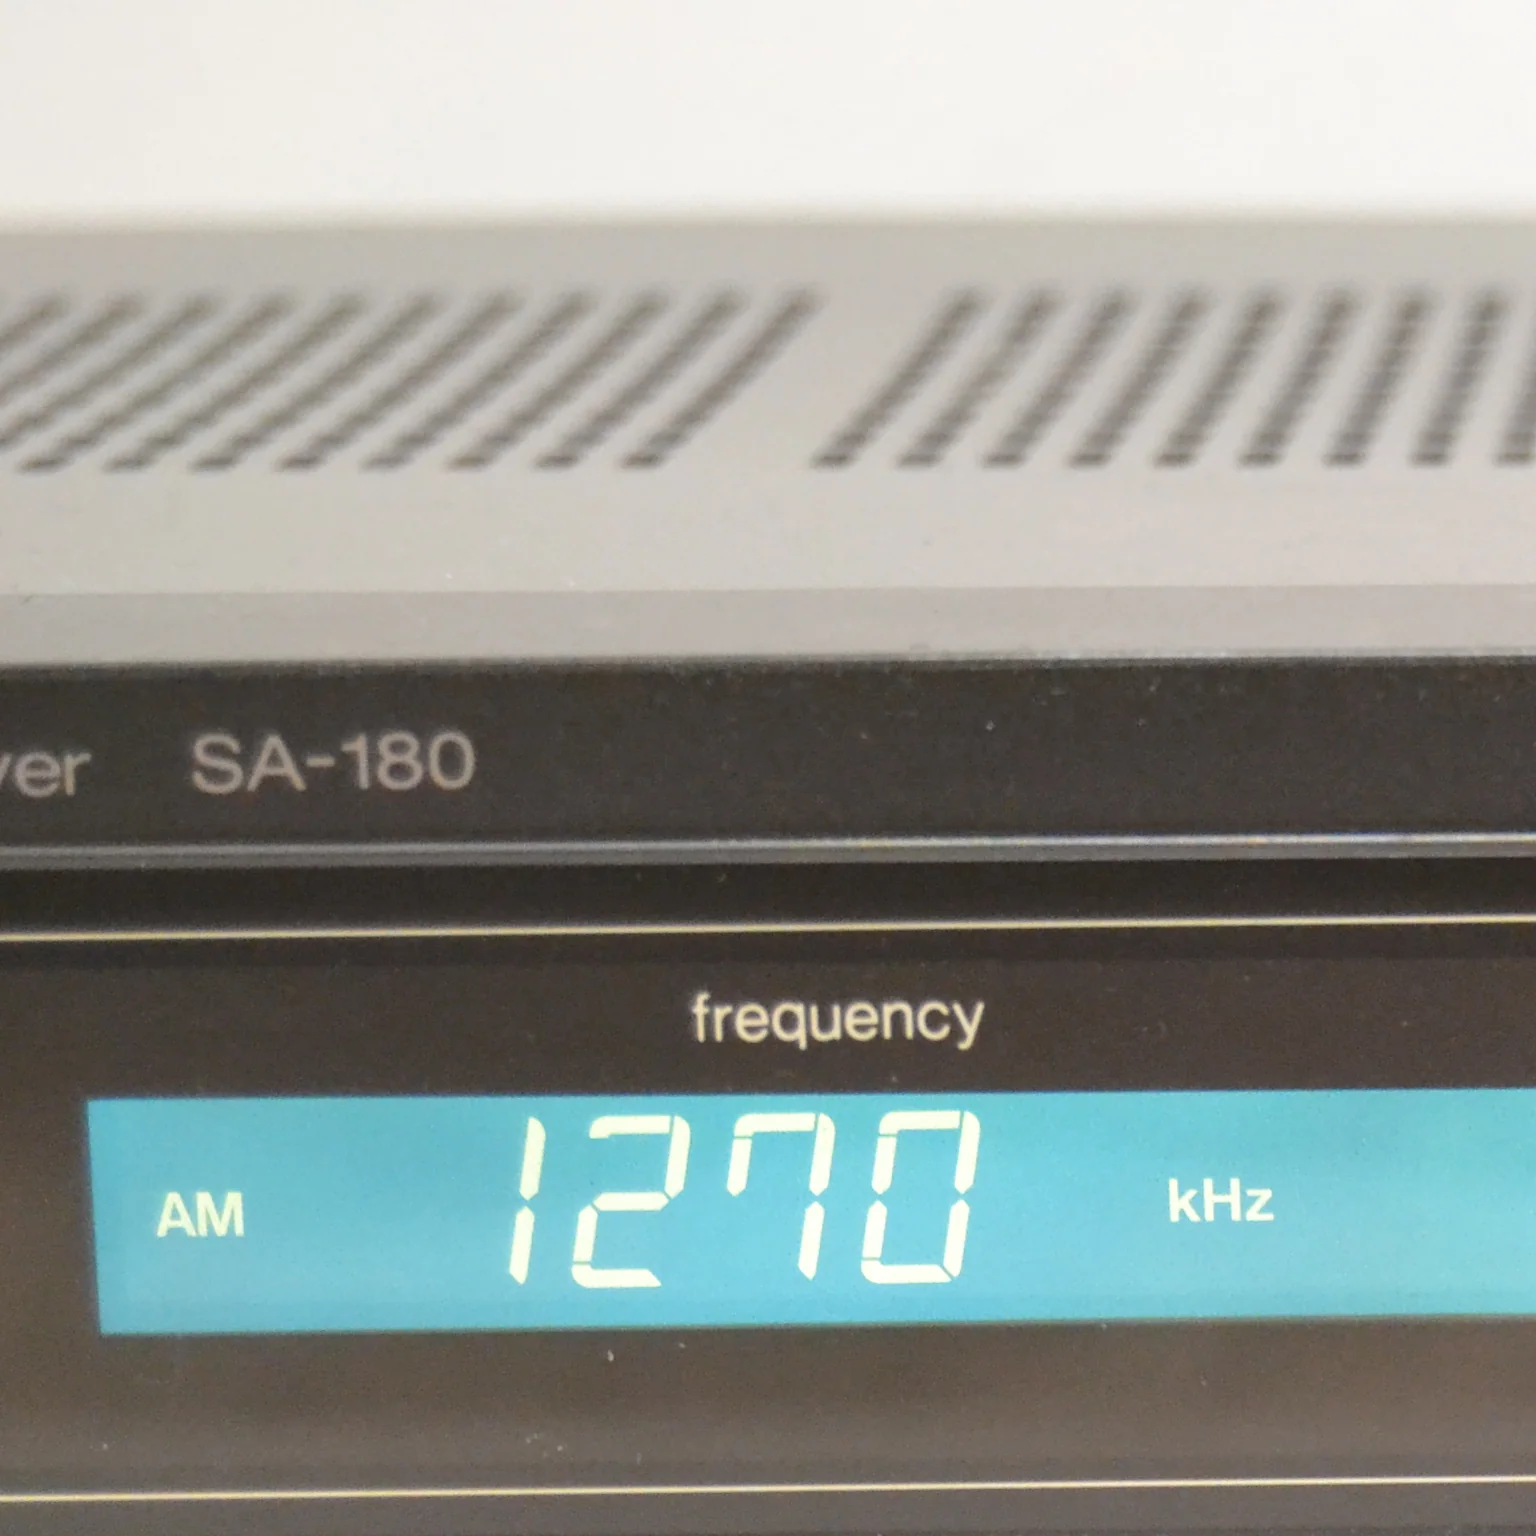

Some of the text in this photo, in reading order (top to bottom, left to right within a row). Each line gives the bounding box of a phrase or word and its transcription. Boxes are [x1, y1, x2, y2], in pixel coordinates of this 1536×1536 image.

[192, 731, 476, 795] SA-180
[691, 992, 985, 1051] frequency
[156, 1110, 1275, 1289] AM 1270 kHz
